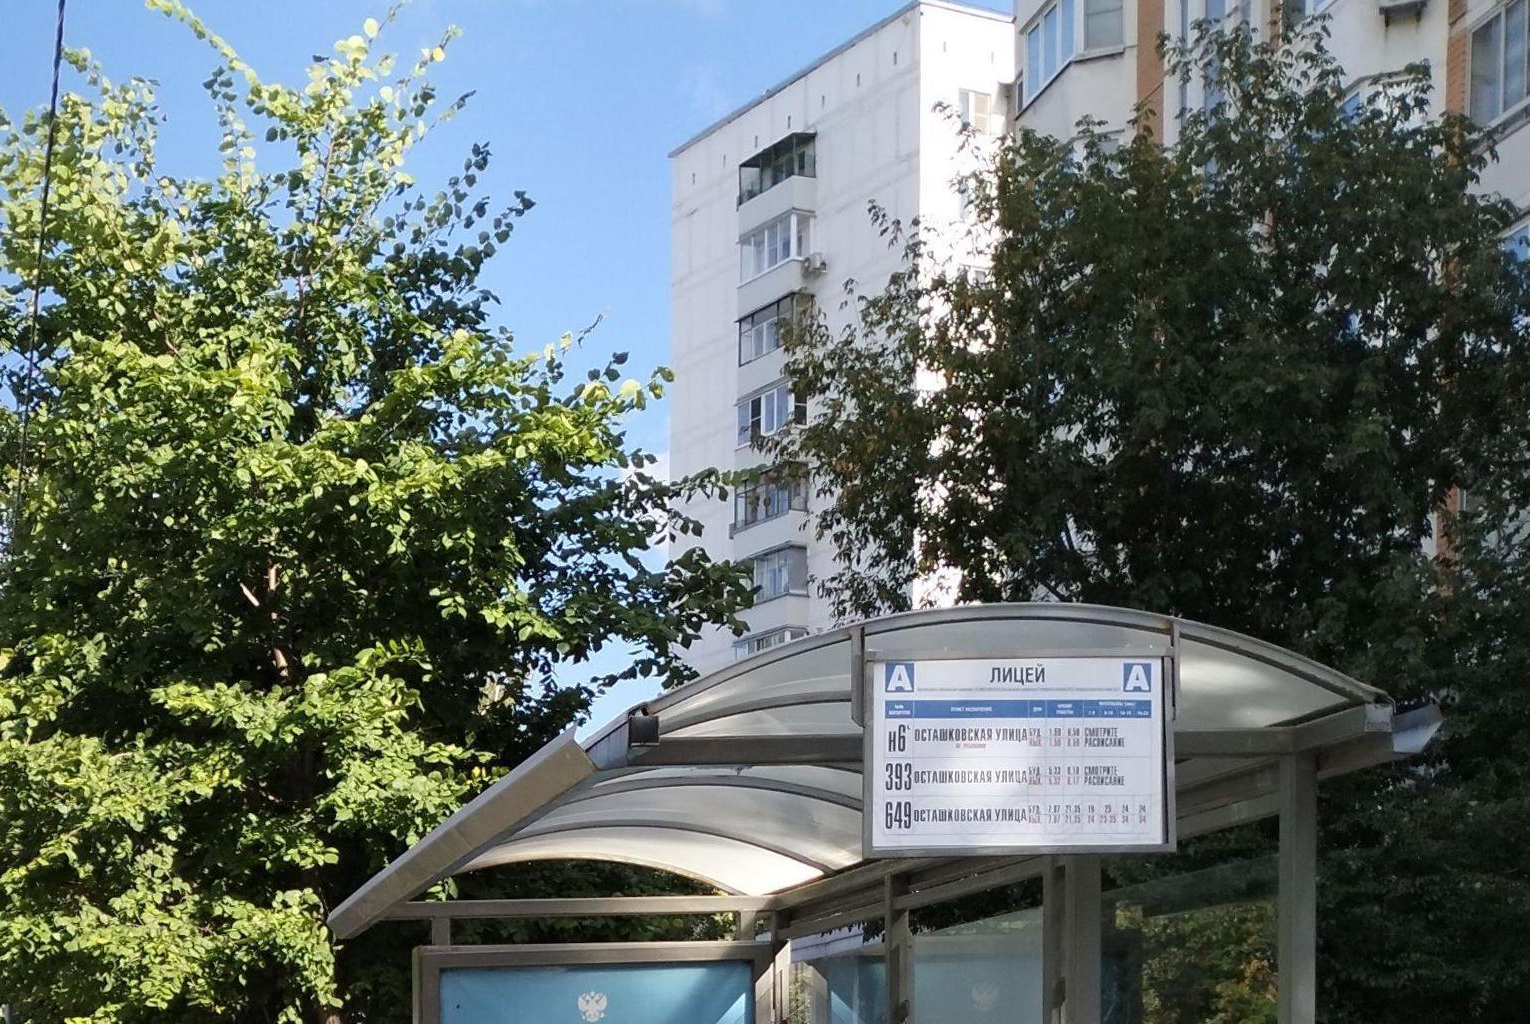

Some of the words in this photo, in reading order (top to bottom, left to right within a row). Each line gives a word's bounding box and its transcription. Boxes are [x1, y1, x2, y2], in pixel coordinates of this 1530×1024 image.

[989, 664, 1046, 685] ЛИЦЕЙ
[914, 728, 992, 742] ОСТАШКОВСКАЯ
[995, 728, 1027, 743] УЛИЦА
[1084, 727, 1118, 737] СМОТРИТЕ
[1084, 737, 1125, 747] РАСПИСАНИЕ
[885, 763, 912, 790] 393
[914, 770, 991, 784] ОСТАШКОВСКАЯ
[995, 770, 1027, 785] УЛИЦА
[1084, 766, 1118, 775] СМОТРИТЕ
[1084, 776, 1125, 785] РАСПИСАНИЕ
[885, 801, 912, 829] 649
[913, 809, 991, 822] ОСТАШКОВСКАЯ
[995, 808, 1027, 823] УЛИЦА
